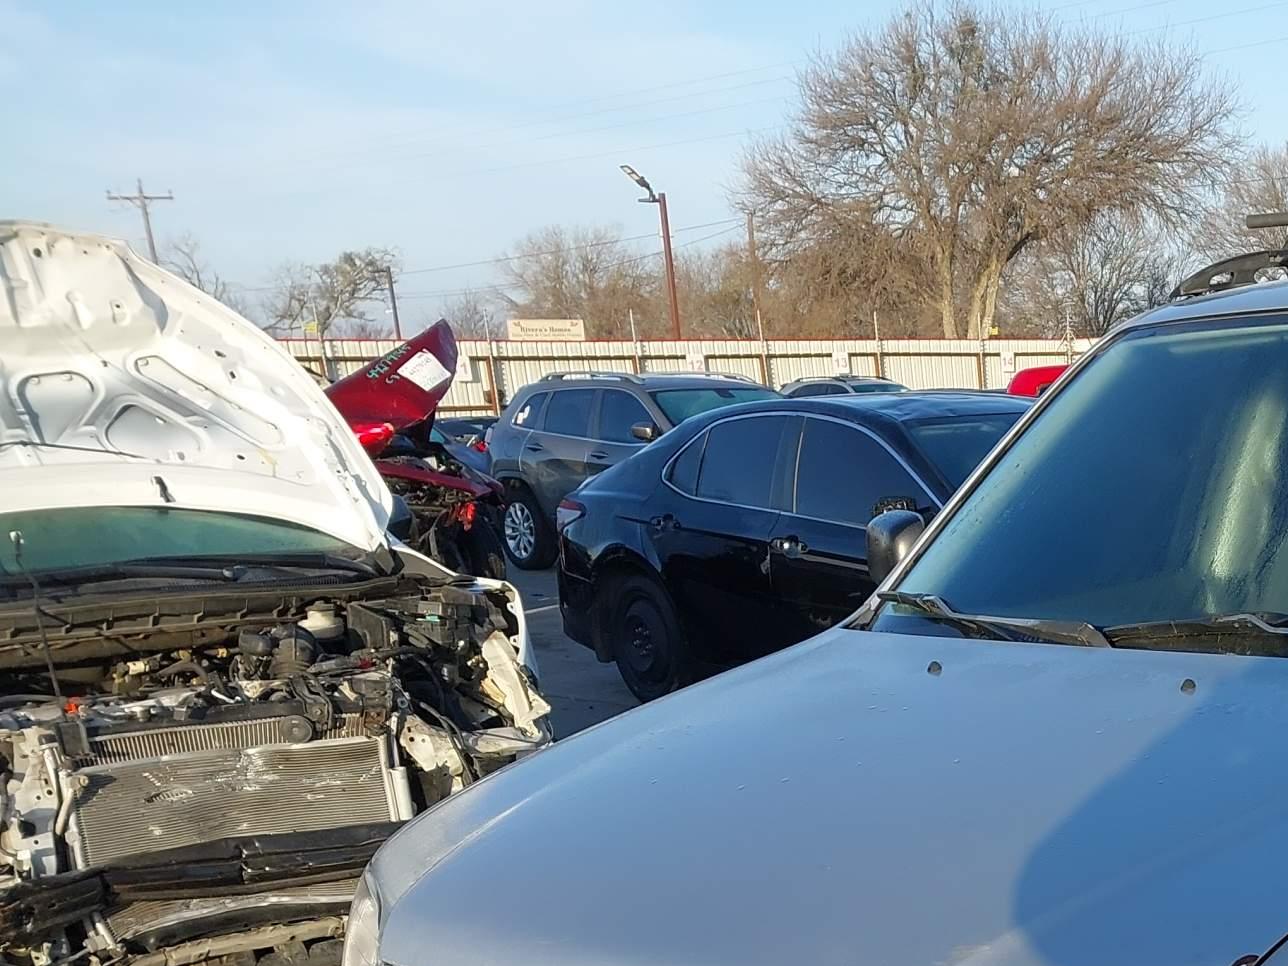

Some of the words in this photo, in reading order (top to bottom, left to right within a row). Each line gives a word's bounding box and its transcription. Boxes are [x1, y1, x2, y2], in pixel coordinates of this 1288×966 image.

[688, 359, 704, 370] 12
[835, 357, 848, 369] 13
[1003, 356, 1013, 367] 14
